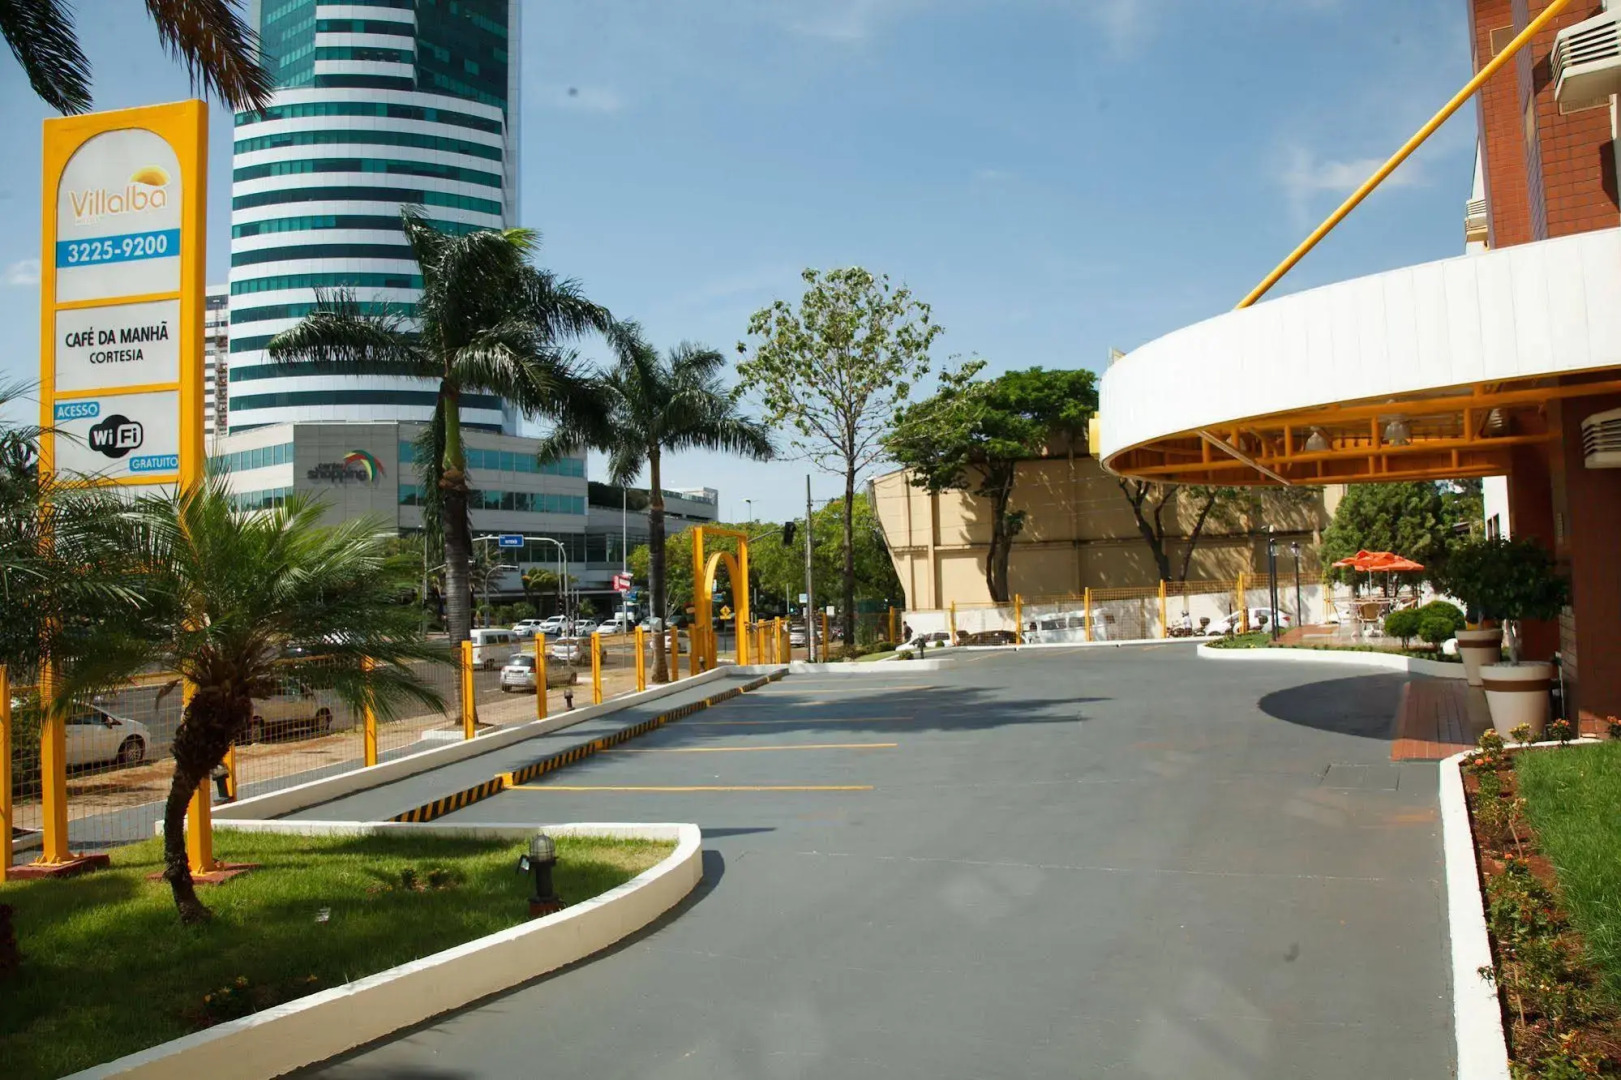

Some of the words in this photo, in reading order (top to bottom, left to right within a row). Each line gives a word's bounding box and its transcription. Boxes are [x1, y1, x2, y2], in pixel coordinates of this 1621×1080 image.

[70, 184, 167, 218] Villalba
[67, 234, 168, 263] 3225-9200
[65, 326, 94, 348] CAFÉ
[98, 329, 117, 345] DA
[120, 320, 169, 343] MANHÃ
[89, 348, 144, 364] CORTESIA
[57, 403, 98, 418] ACESSO
[132, 457, 178, 469] GRATUITO
